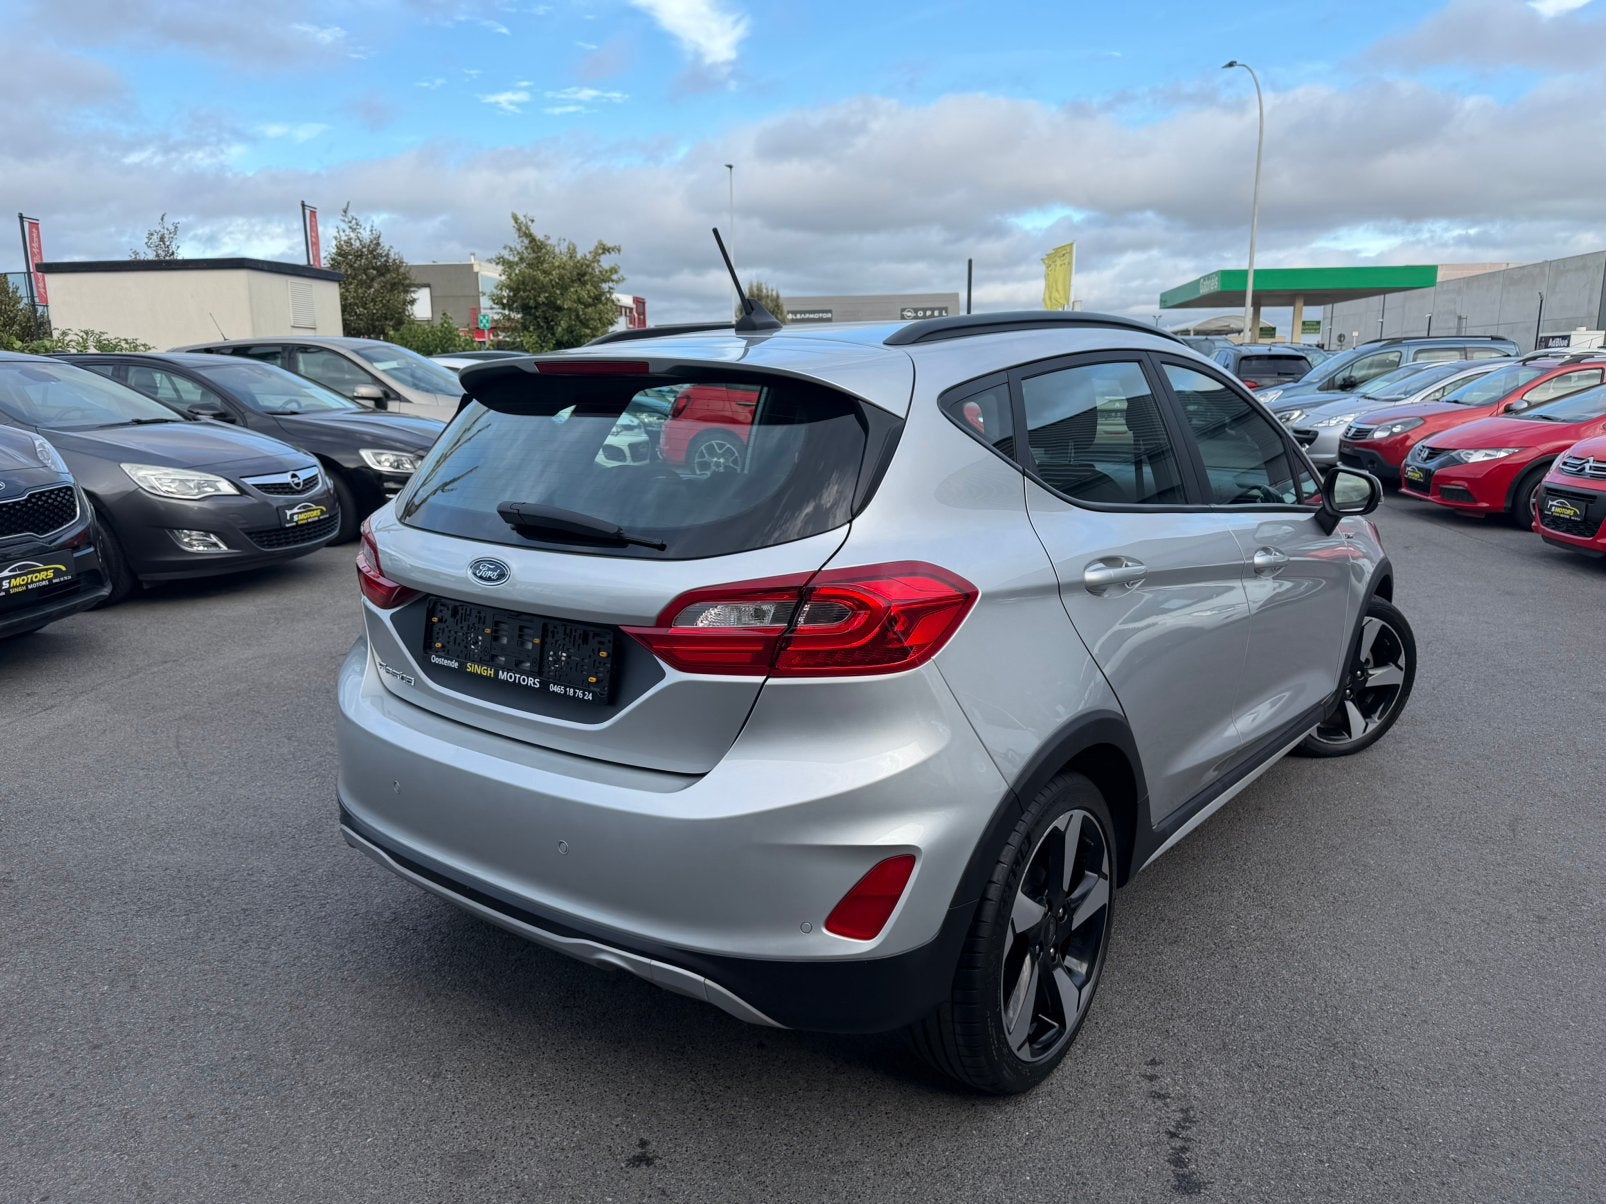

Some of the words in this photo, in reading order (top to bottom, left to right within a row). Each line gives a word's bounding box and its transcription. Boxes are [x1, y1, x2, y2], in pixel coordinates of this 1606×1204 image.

[917, 309, 947, 317] OPEL
[1, 579, 10, 589] S
[10, 569, 54, 587] MOTORS
[476, 563, 500, 579] Ford
[9, 586, 27, 594] SINGH
[27, 580, 49, 590] MOTORS
[430, 654, 459, 669] Oostende
[466, 662, 495, 678] SINGH
[498, 670, 540, 688] MOTORS
[549, 683, 565, 694] 0465
[566, 687, 574, 696] 18
[574, 689, 583, 698] 76
[583, 691, 593, 700] 24
